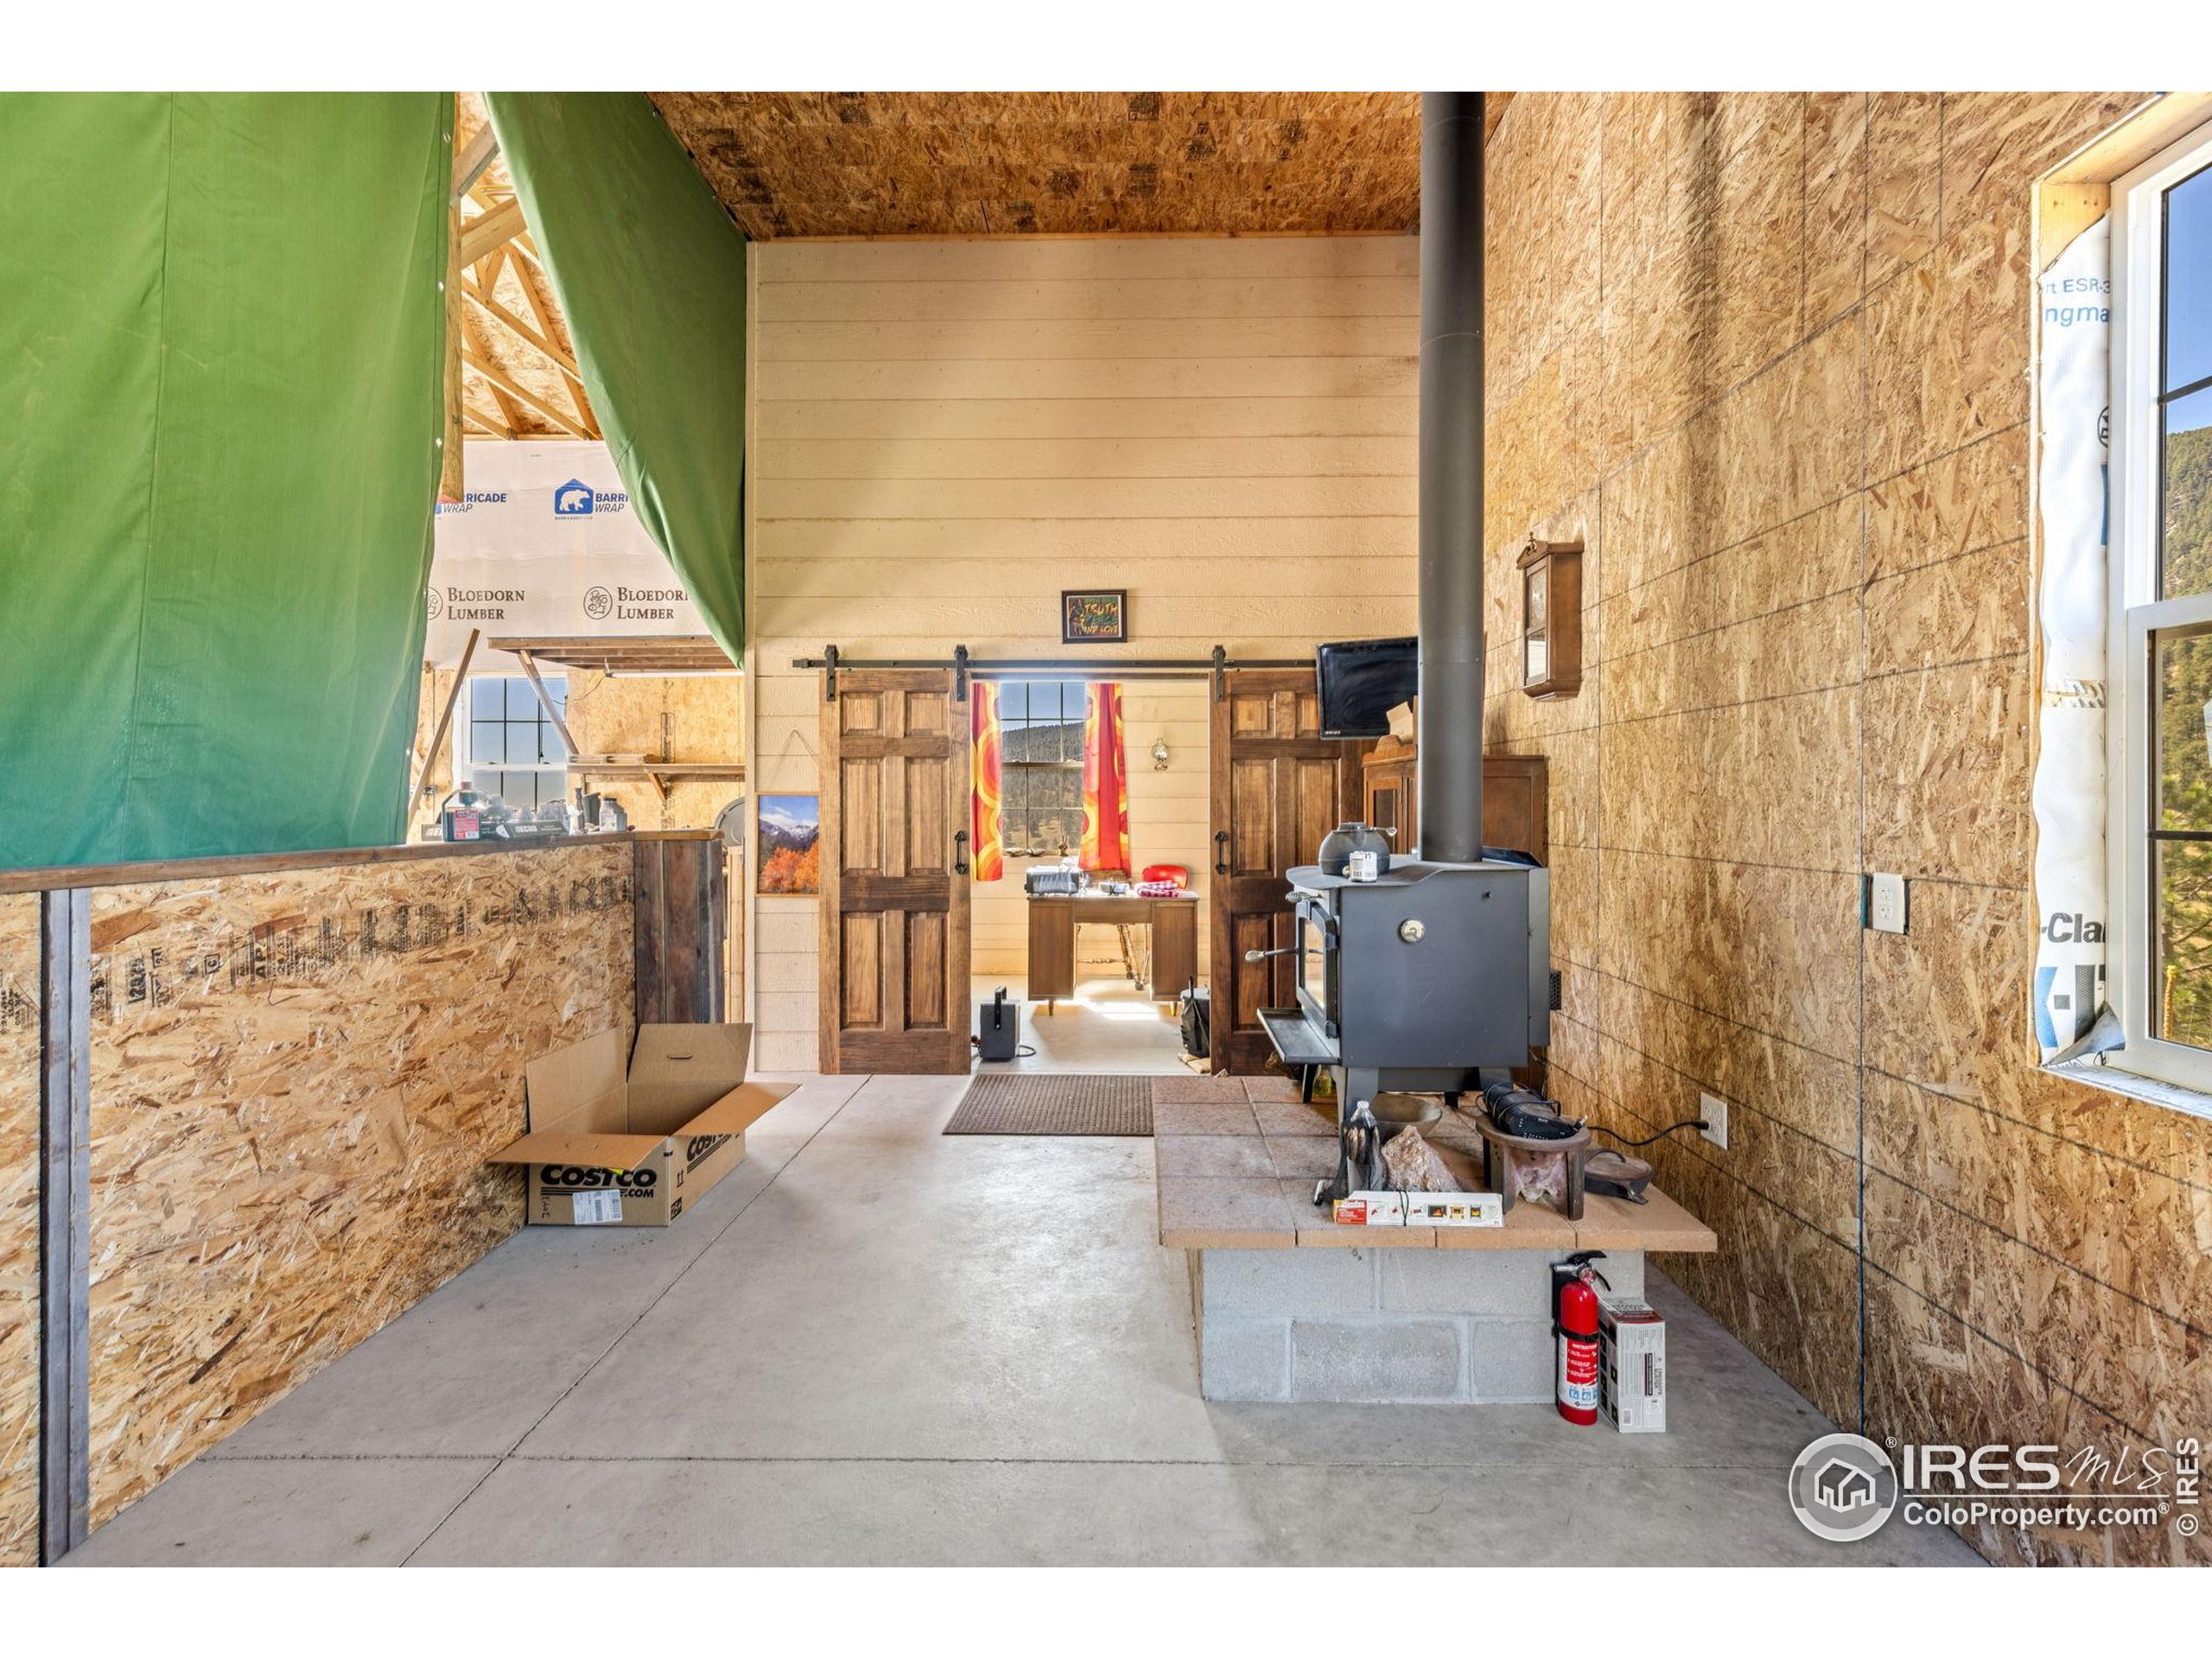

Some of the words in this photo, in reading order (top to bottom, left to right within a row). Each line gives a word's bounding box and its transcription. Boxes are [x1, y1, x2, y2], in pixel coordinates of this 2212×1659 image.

[2063, 277, 2111, 294] ESR-3
[2045, 307, 2110, 327] ngma
[466, 493, 507, 503] RICADE
[595, 493, 629, 503] BARRI
[443, 503, 473, 513] WRAP
[594, 503, 624, 513] WRAP
[1084, 603, 1117, 616] TRUTH
[2042, 912, 2106, 944] -Cla
[540, 1164, 658, 1187] COSTCO
